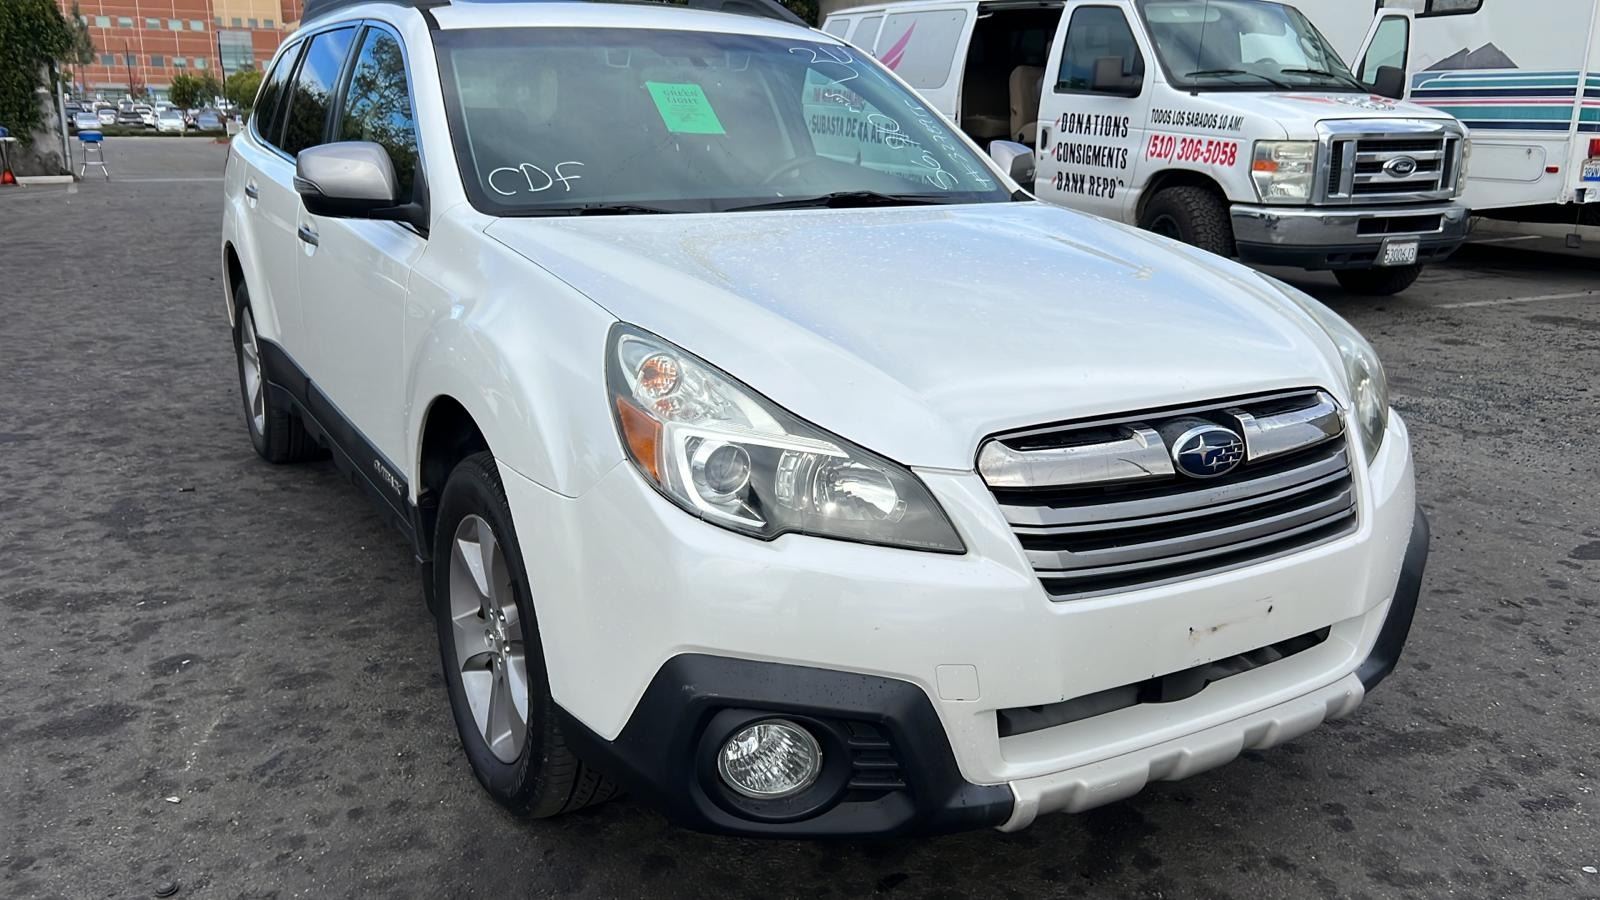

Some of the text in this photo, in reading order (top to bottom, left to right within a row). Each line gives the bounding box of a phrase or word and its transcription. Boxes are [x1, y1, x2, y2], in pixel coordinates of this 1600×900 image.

[811, 113, 844, 136] SUBASTA
[846, 117, 858, 138] DE
[1061, 112, 1129, 138] DONATIONS
[1151, 108, 1172, 124] TODOS
[1172, 110, 1185, 126] LOS
[1186, 111, 1217, 129] SABADOS
[1218, 114, 1228, 130] 10
[1056, 141, 1128, 169] CONSIGMENTS
[1145, 134, 1238, 167] (510) 306-5058
[488, 161, 585, 196] CDF
[1056, 170, 1085, 195] BANK
